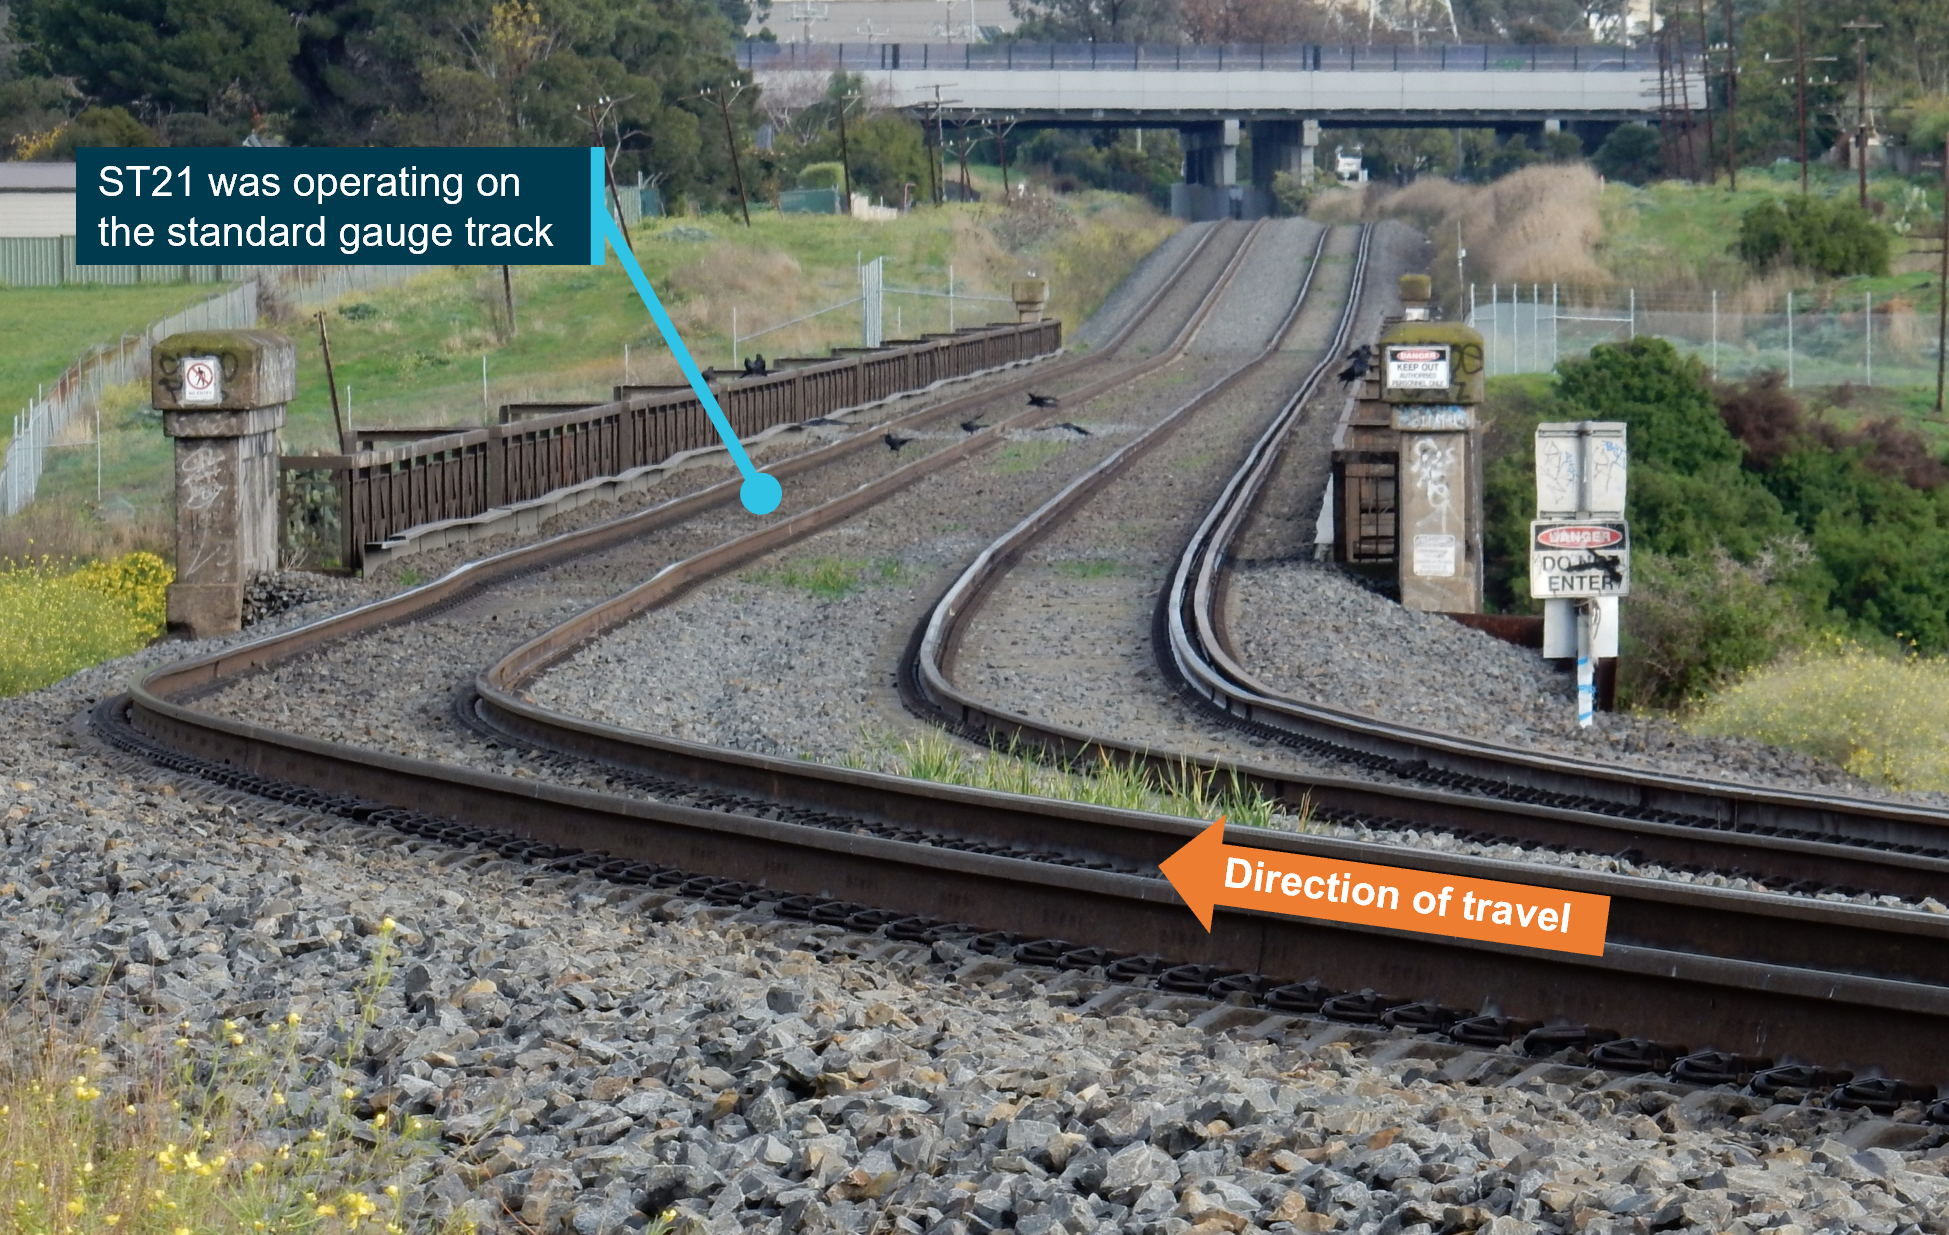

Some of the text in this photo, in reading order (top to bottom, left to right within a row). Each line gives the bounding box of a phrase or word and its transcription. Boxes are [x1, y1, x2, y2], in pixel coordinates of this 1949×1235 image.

[1401, 352, 1437, 360] DANGER
[1397, 363, 1439, 372] KEEP OUT
[1542, 555, 1572, 572] DO
[1548, 575, 1614, 592] ENTER
